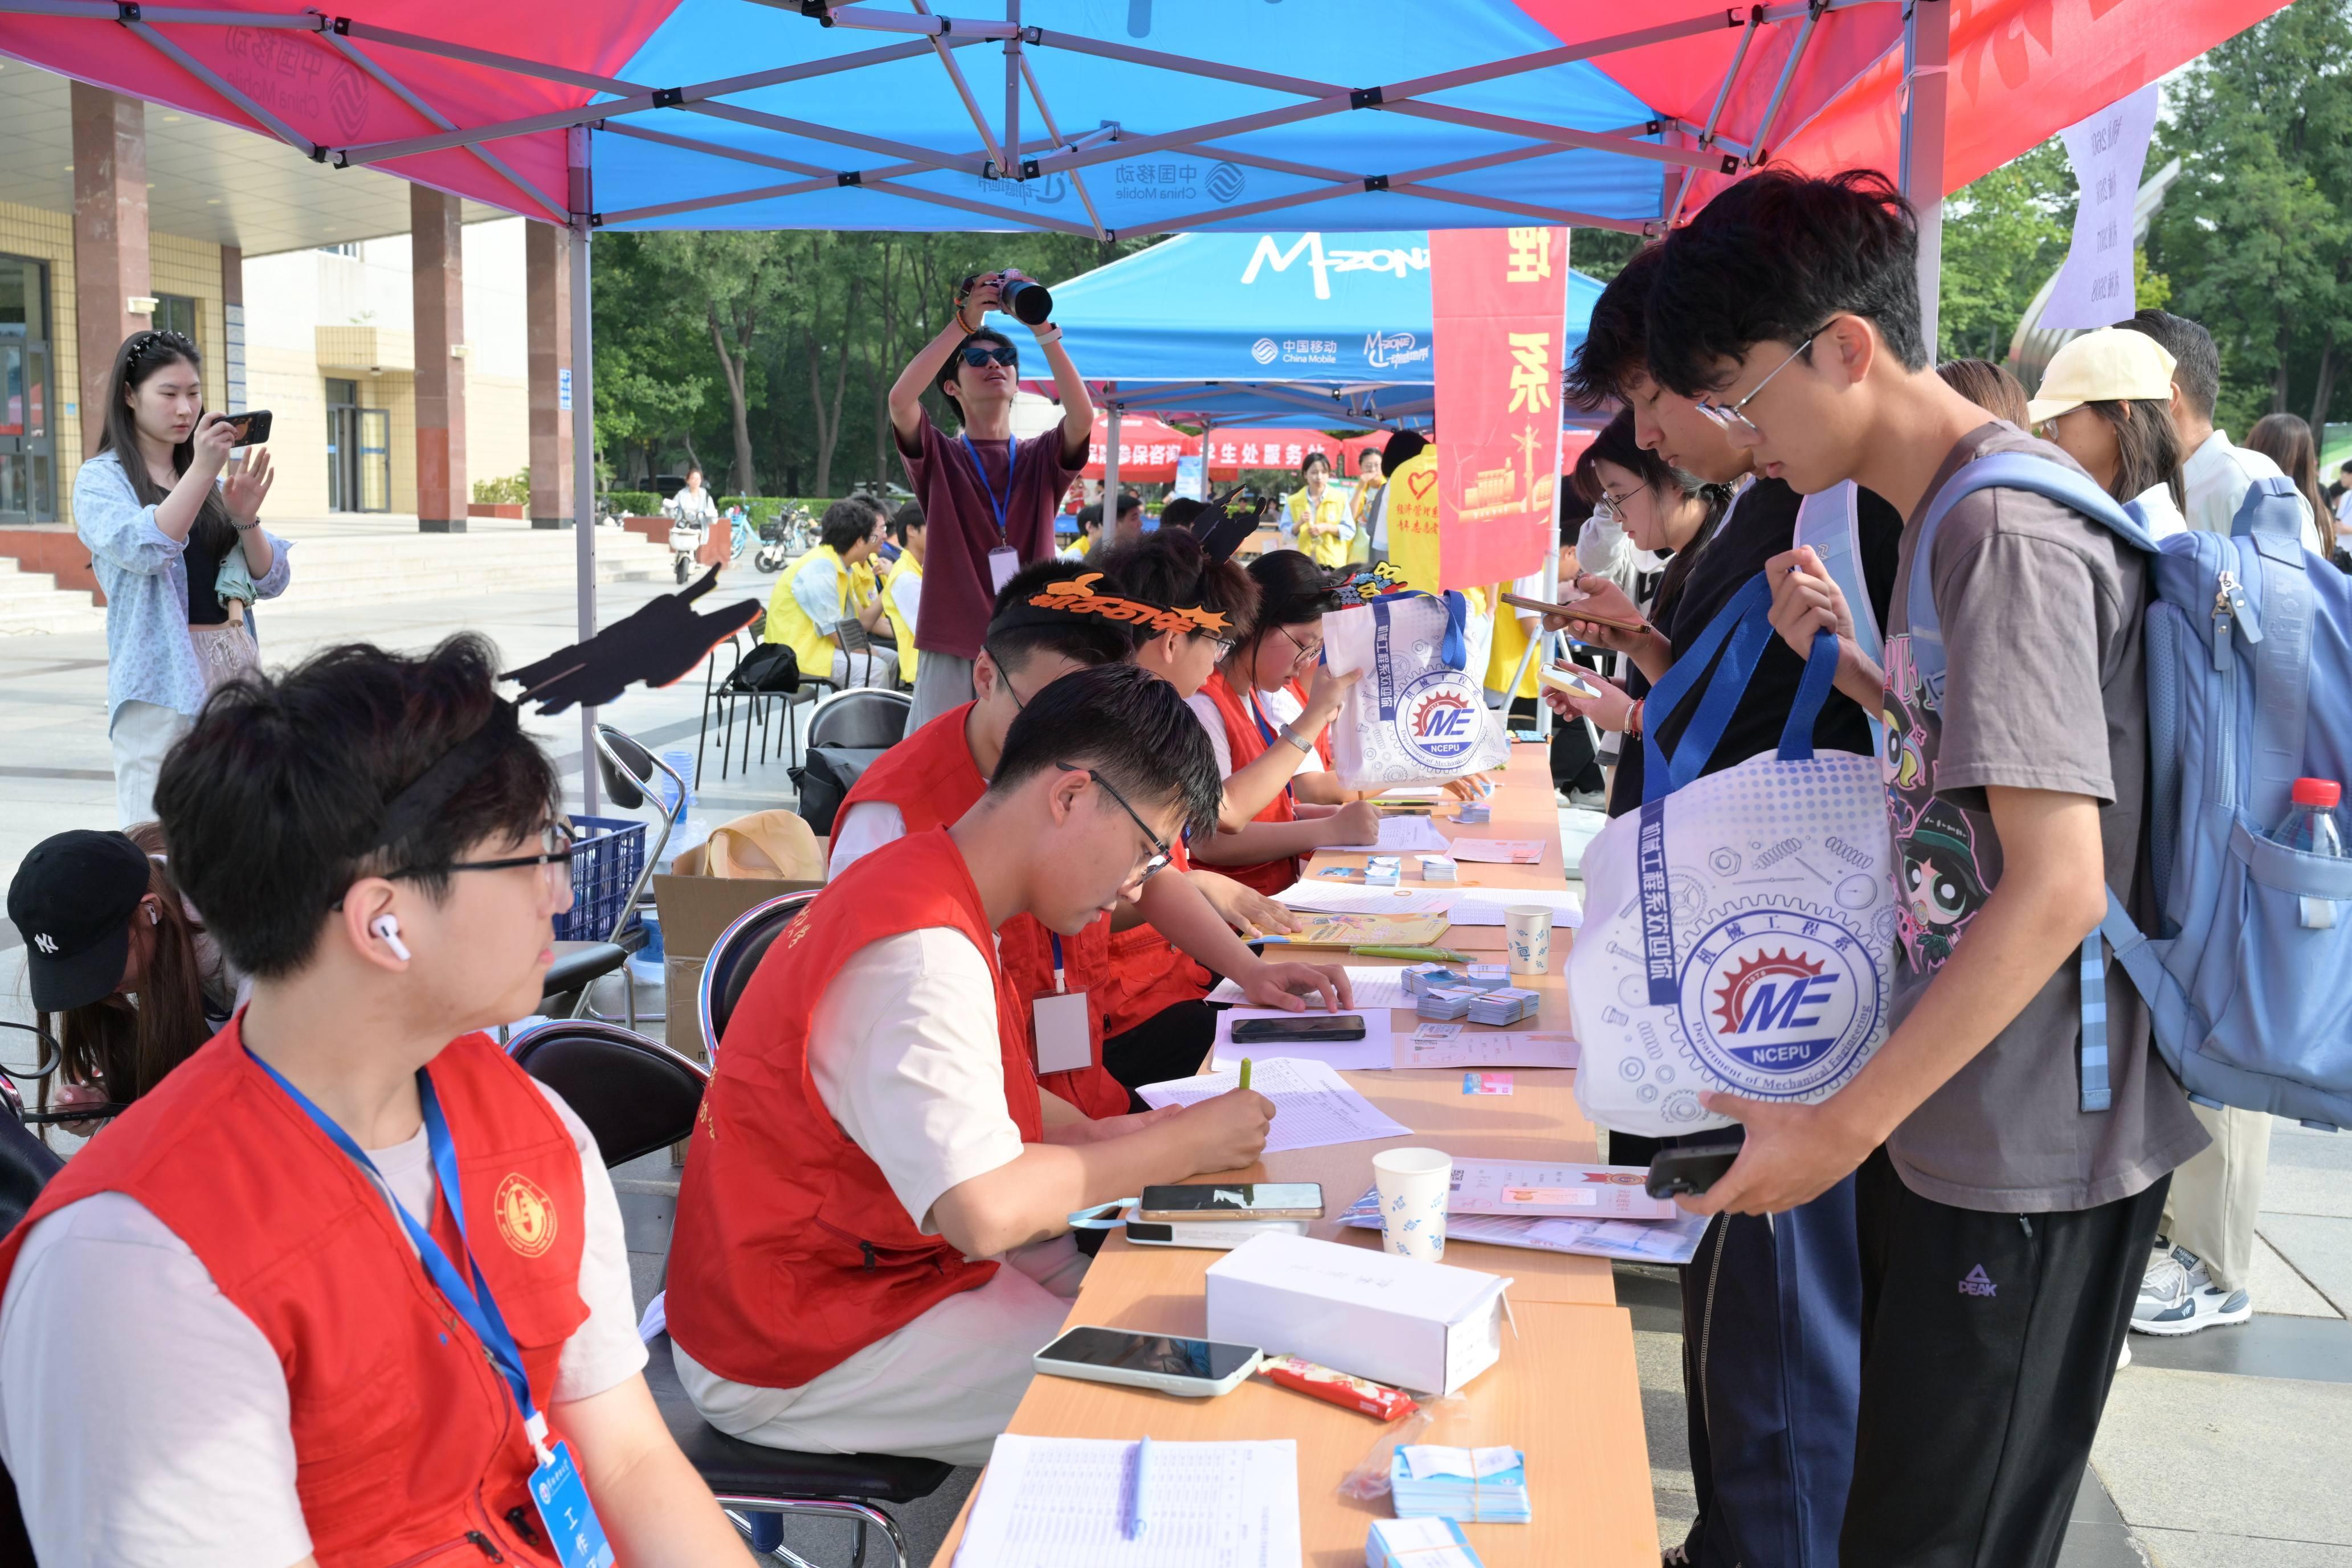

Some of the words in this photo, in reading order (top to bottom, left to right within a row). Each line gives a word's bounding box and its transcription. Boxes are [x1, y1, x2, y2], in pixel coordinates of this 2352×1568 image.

[1241, 232, 1430, 300] M-ZON
[1283, 340, 1337, 353] 中国移动
[1283, 354, 1306, 364] China
[1308, 354, 1336, 364] Mobile
[1424, 708, 1475, 737] ME
[1401, 730, 1426, 762] Department
[1435, 755, 1467, 766] Mechanical
[1641, 821, 1672, 981] 机械工程系欢迎你
[34, 933, 59, 953] NY
[1696, 915, 1855, 965] 机械工程系
[1736, 973, 1840, 1034] ME
[1693, 1021, 1742, 1079] Department
[1745, 1075, 1758, 1085] of
[1763, 1067, 1828, 1089] Mechanical
[1828, 1004, 1872, 1071] Engineering
[1752, 1044, 1810, 1064] NCEPU
[2177, 1247, 2195, 1263] FASHION
[1958, 1280, 1997, 1297] PEAK
